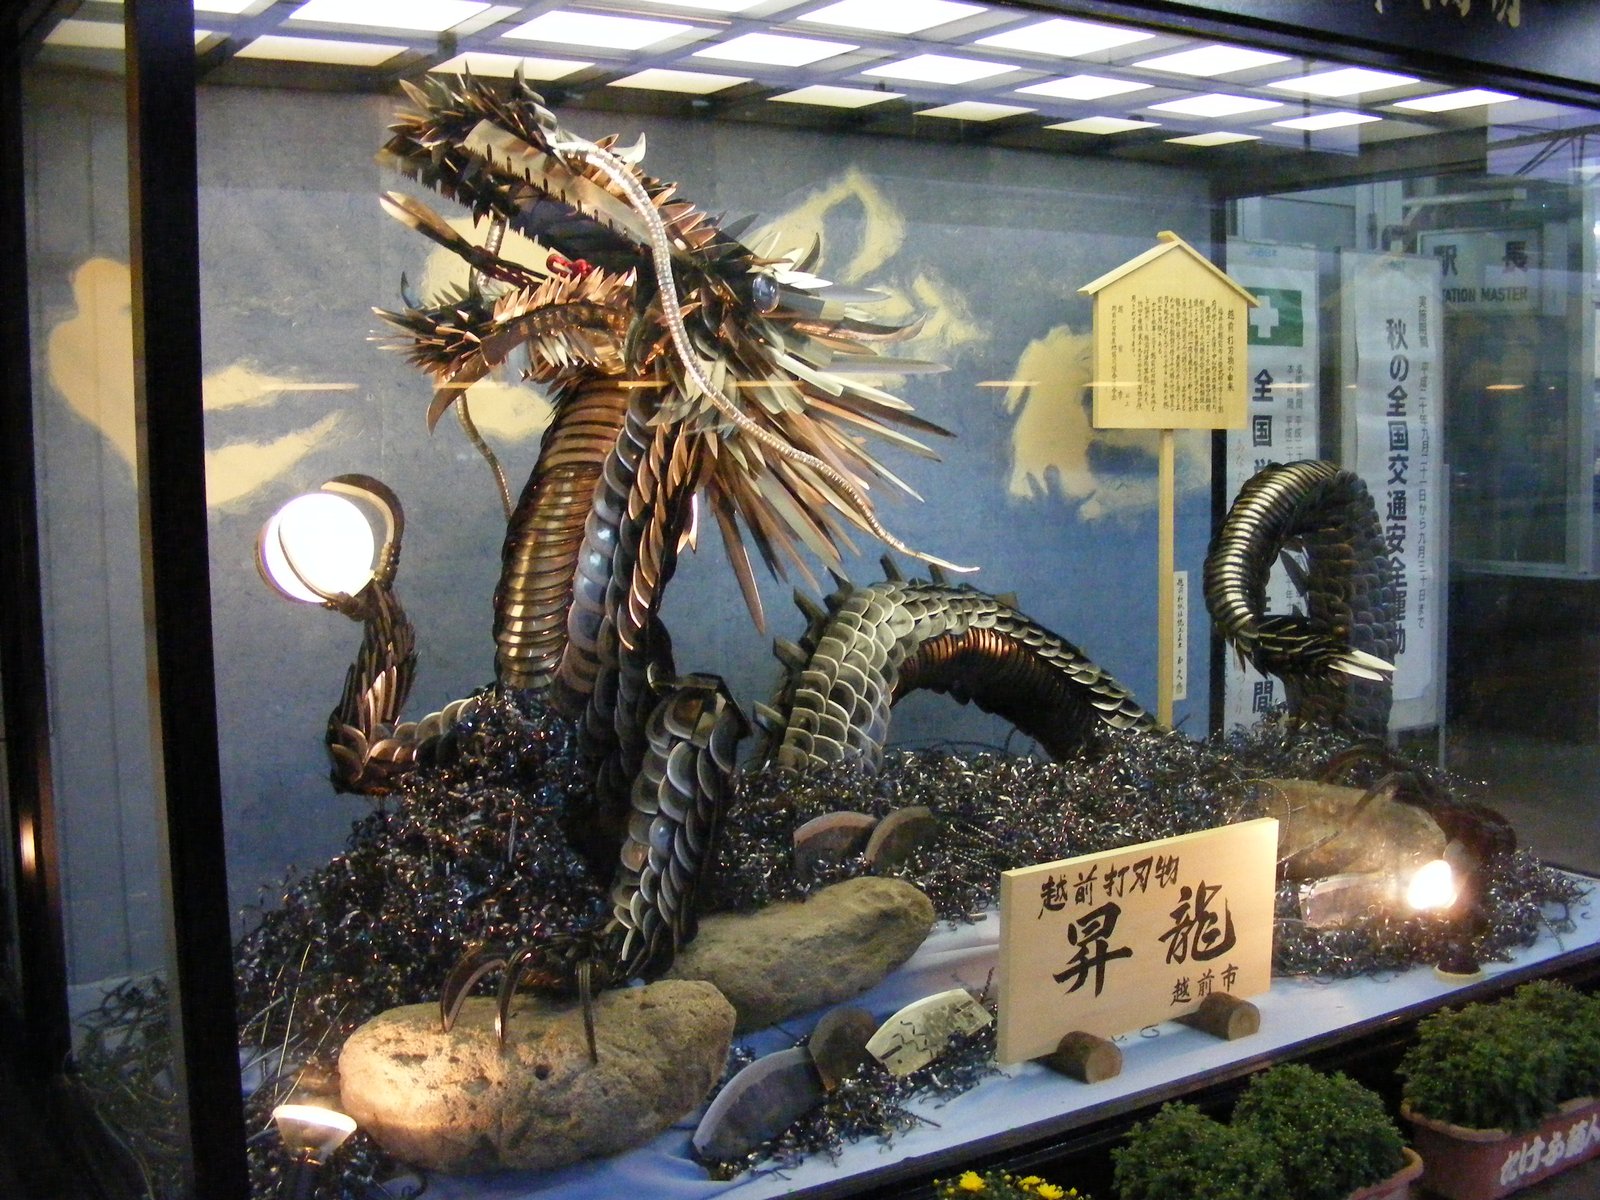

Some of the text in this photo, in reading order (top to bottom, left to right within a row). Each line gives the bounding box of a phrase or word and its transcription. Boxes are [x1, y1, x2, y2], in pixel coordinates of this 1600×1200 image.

[1441, 287, 1528, 302] TATION MASTER
[1385, 318, 1409, 655] 秋の全国交通安全運動
[1038, 855, 1180, 920] 越前打刃物
[1170, 963, 1239, 1006] 越前市
